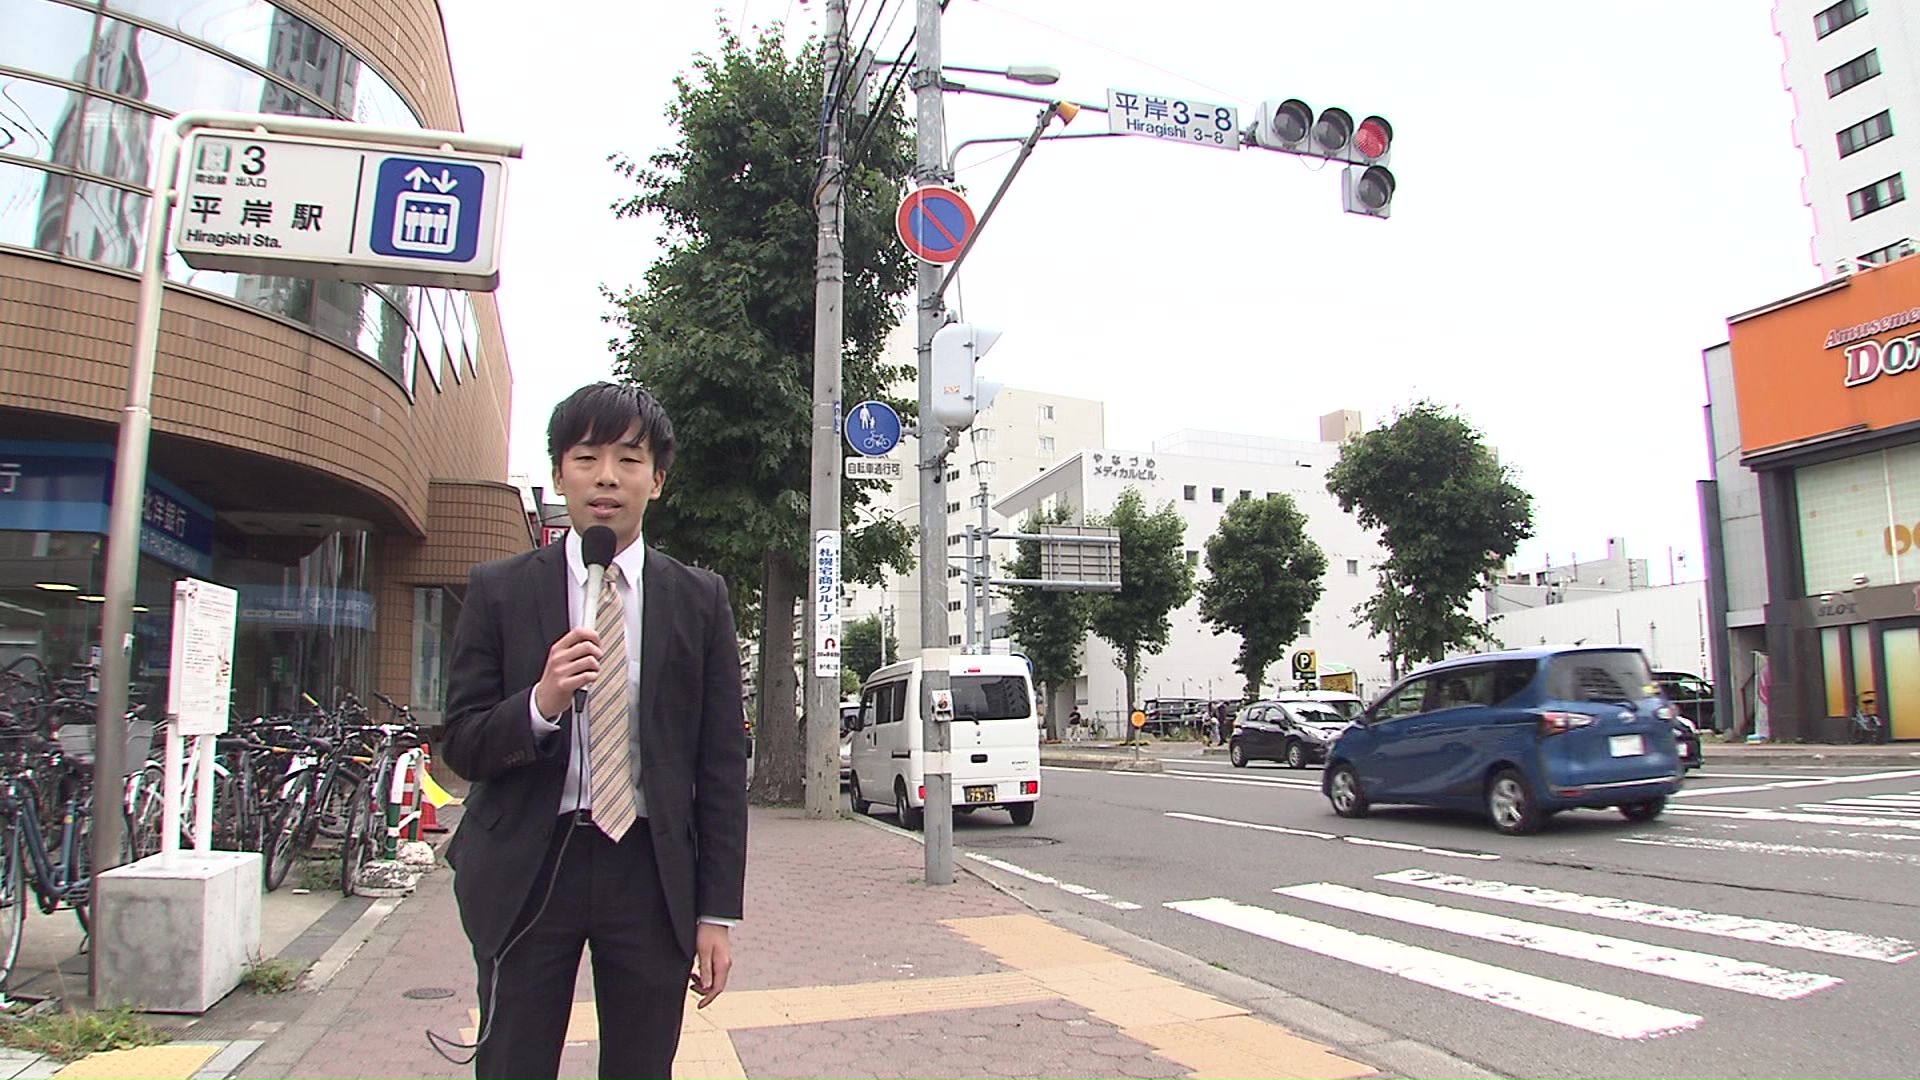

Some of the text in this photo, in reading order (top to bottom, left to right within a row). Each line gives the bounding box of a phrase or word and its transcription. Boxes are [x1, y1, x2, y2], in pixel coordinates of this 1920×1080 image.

[1126, 118, 1224, 144] Hiragishi 3-8
[241, 145, 266, 175] 3
[235, 176, 267, 188] 出入口
[190, 195, 323, 231] 平岸駅
[186, 229, 282, 248] Hiragishi Sta.
[1093, 465, 1157, 480] メディカルビル
[1817, 602, 1858, 617] SLOT
